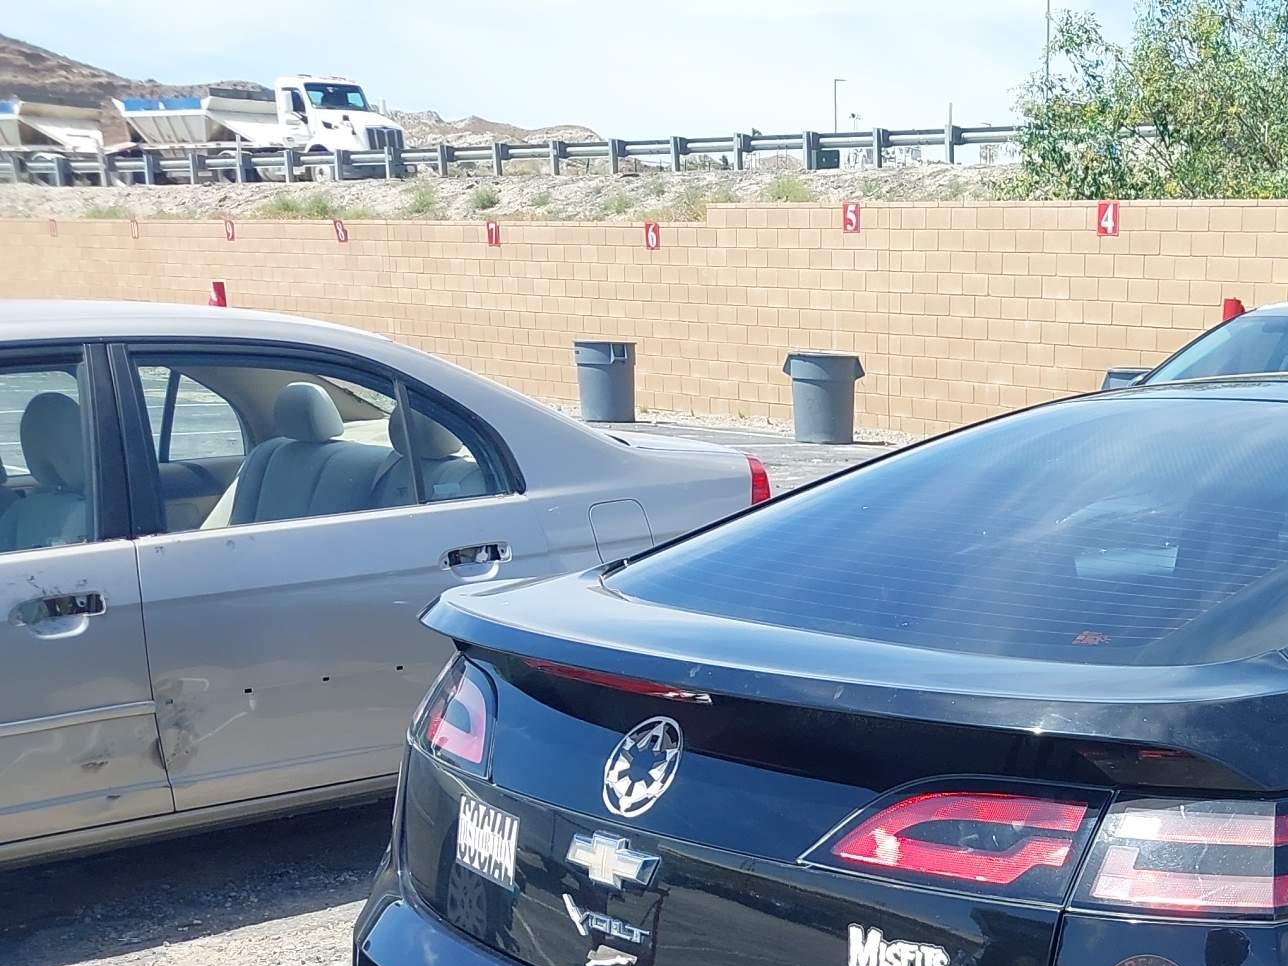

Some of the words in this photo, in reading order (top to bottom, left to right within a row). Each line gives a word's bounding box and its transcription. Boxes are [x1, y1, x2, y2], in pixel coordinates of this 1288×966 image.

[846, 204, 857, 231] 5
[1101, 203, 1114, 234] 4
[226, 221, 233, 240] 9
[335, 221, 345, 241] 8
[488, 222, 497, 245] 7
[647, 224, 657, 248] 6
[562, 893, 650, 944] VOLT
